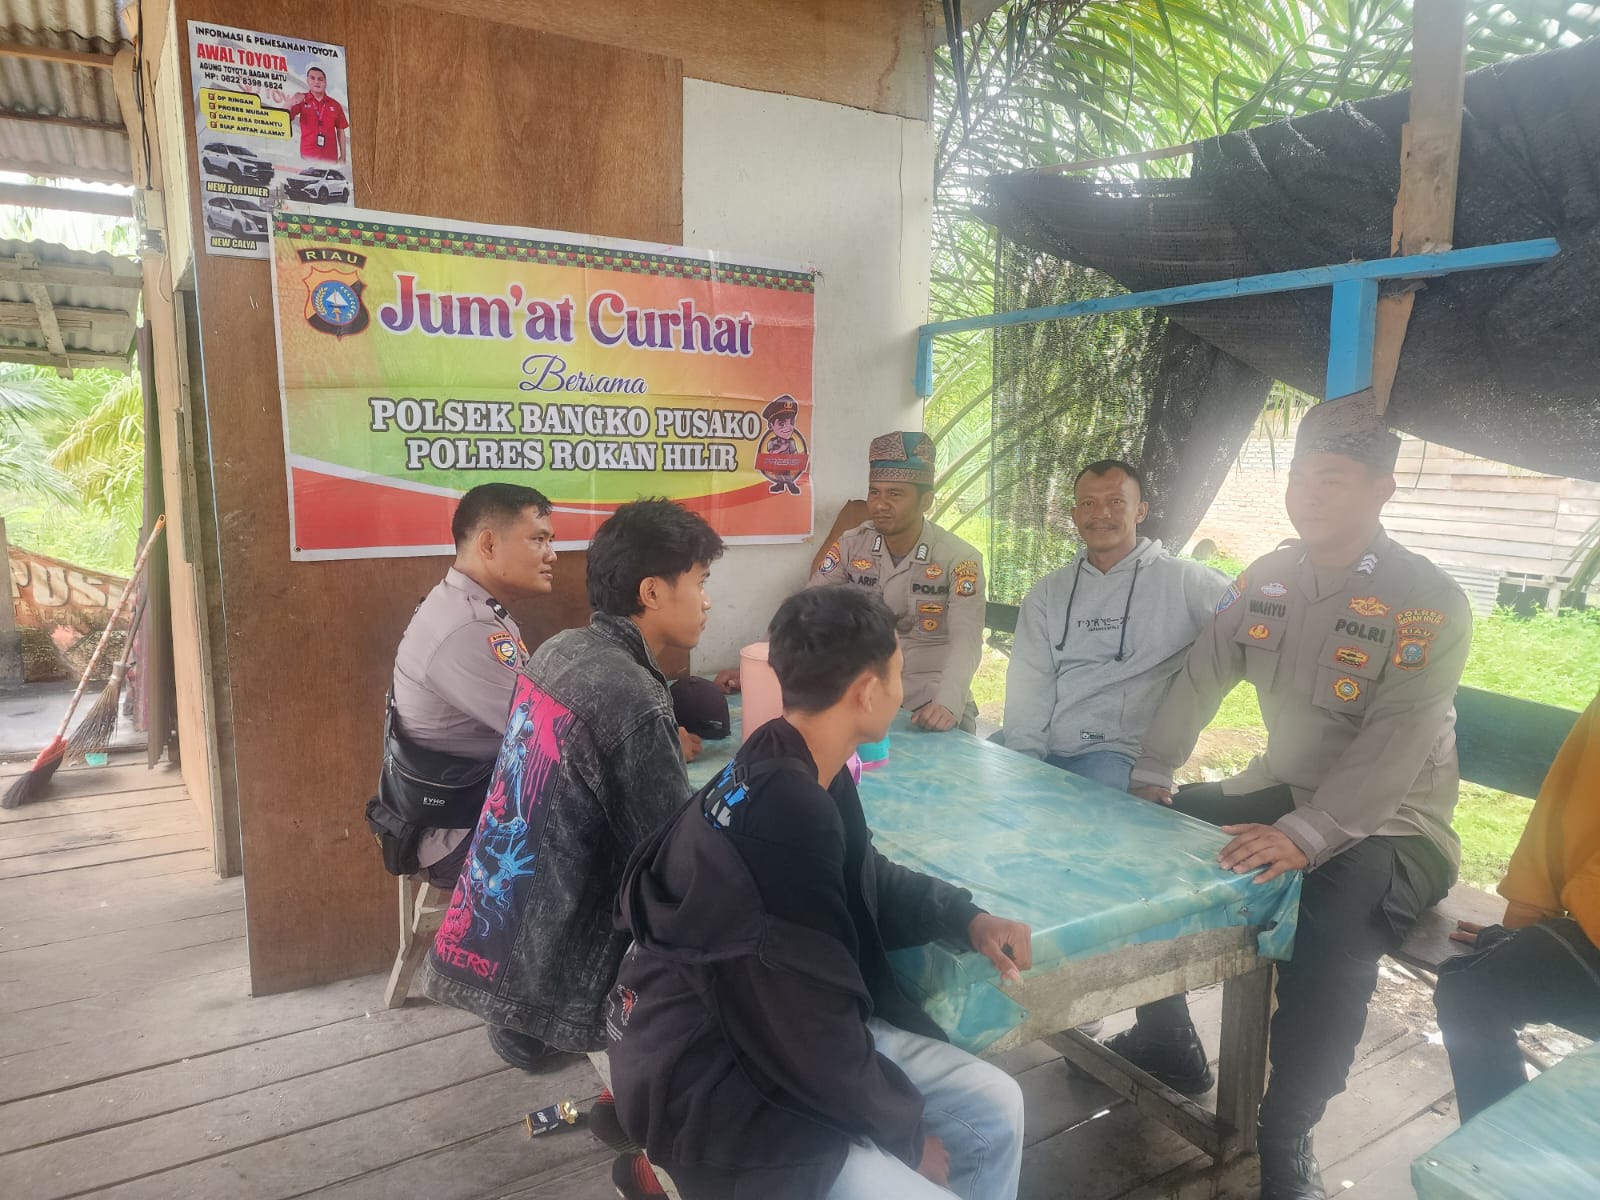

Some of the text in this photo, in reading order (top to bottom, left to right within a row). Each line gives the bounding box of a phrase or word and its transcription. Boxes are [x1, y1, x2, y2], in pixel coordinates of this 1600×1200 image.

[195, 26, 339, 58] INFORMASI & PEMESANAN TOYOTA
[196, 43, 288, 72] AWAL TOYOTA
[200, 62, 287, 82] AGUNG TOYOTA BAGAN BATU
[204, 72, 219, 80] HP:
[220, 74, 241, 84] 0822
[207, 181, 269, 198] NEW FORTUNER
[211, 237, 256, 250] NEW CALYA
[305, 250, 358, 264] RIAU
[379, 273, 752, 356] Jum'at Curhat
[518, 354, 648, 395] Bersama
[369, 398, 761, 441] POLSEK BANGKO PUSAKO
[406, 437, 737, 472] POLRES ROKAN HILIR
[1249, 599, 1287, 618] WAHYU
[1335, 618, 1386, 643] POLRI
